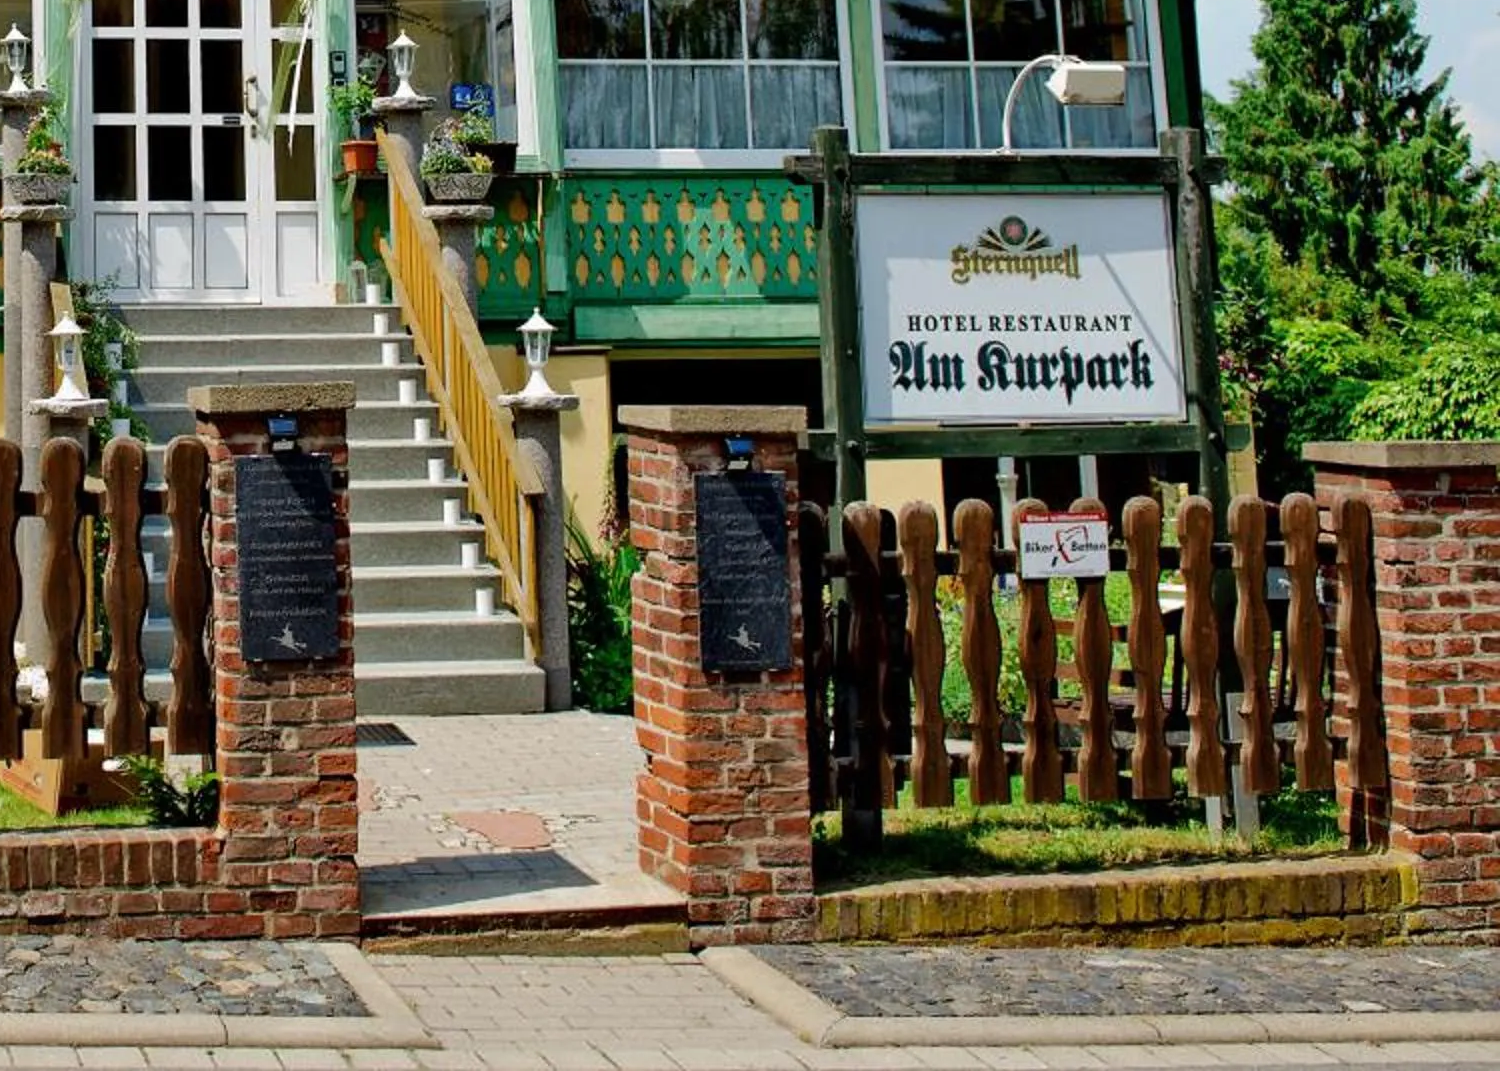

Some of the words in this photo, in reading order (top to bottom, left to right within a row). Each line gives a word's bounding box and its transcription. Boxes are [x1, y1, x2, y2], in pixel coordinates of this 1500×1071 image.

[951, 244, 1080, 284] Sternquell
[908, 314, 982, 332] HOTEL
[988, 314, 1133, 332] RESTAURANT
[889, 340, 966, 392] Am
[976, 338, 1155, 406] Kurpark
